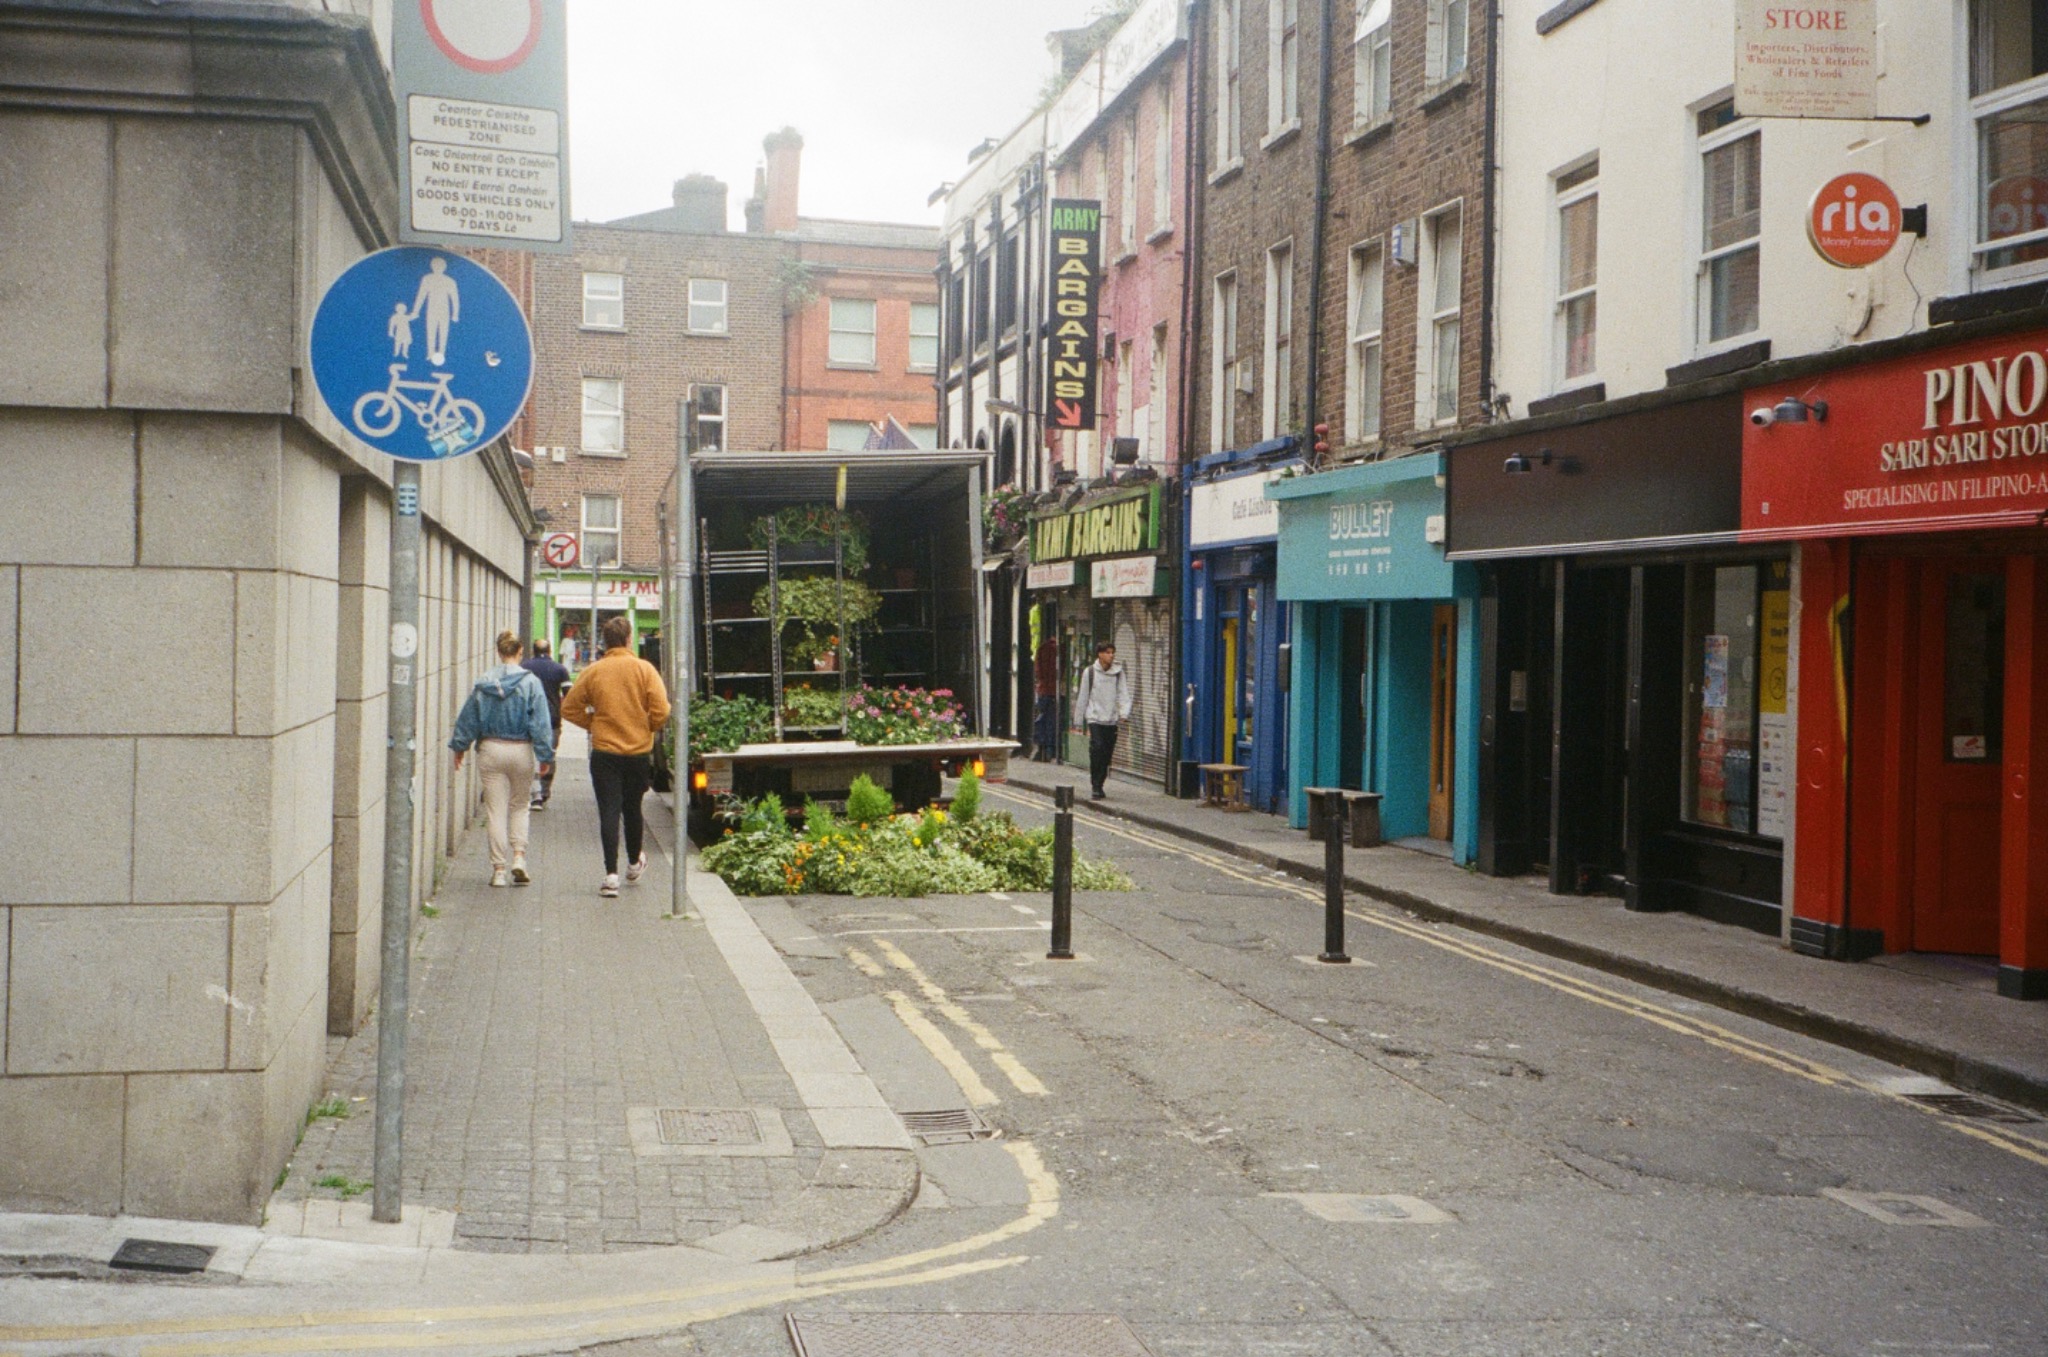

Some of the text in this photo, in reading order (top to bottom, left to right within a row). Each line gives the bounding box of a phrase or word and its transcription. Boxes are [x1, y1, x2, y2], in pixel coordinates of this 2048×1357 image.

[1765, 8, 1848, 31] STORE
[1746, 54, 1870, 66] Wholesalers & Retailers
[1772, 67, 1843, 78] of Fine Foods
[433, 115, 537, 135] PEDESTRIANISED
[468, 131, 502, 143] ZONE
[432, 161, 540, 181] NO ENTRY EXCEPT
[417, 188, 556, 211] GOODS VEHICLES ONLY
[1822, 184, 1890, 232] ria
[459, 219, 466, 228] 7
[469, 221, 500, 232] DAYS
[516, 212, 533, 223] hrs
[1053, 207, 1099, 232] ARMY
[1822, 236, 1889, 248] Money Transfer
[1054, 237, 1091, 398] BARGAINS
[1922, 350, 2048, 430] PINO
[1880, 437, 1930, 472] SARI
[1933, 430, 1989, 467] SARI
[1843, 481, 1938, 510] SPECIALISING
[1942, 479, 1958, 502] IN
[1035, 498, 1143, 563] ARMY BARGAINS
[1329, 500, 1394, 540] BULLET
[608, 580, 616, 594] J
